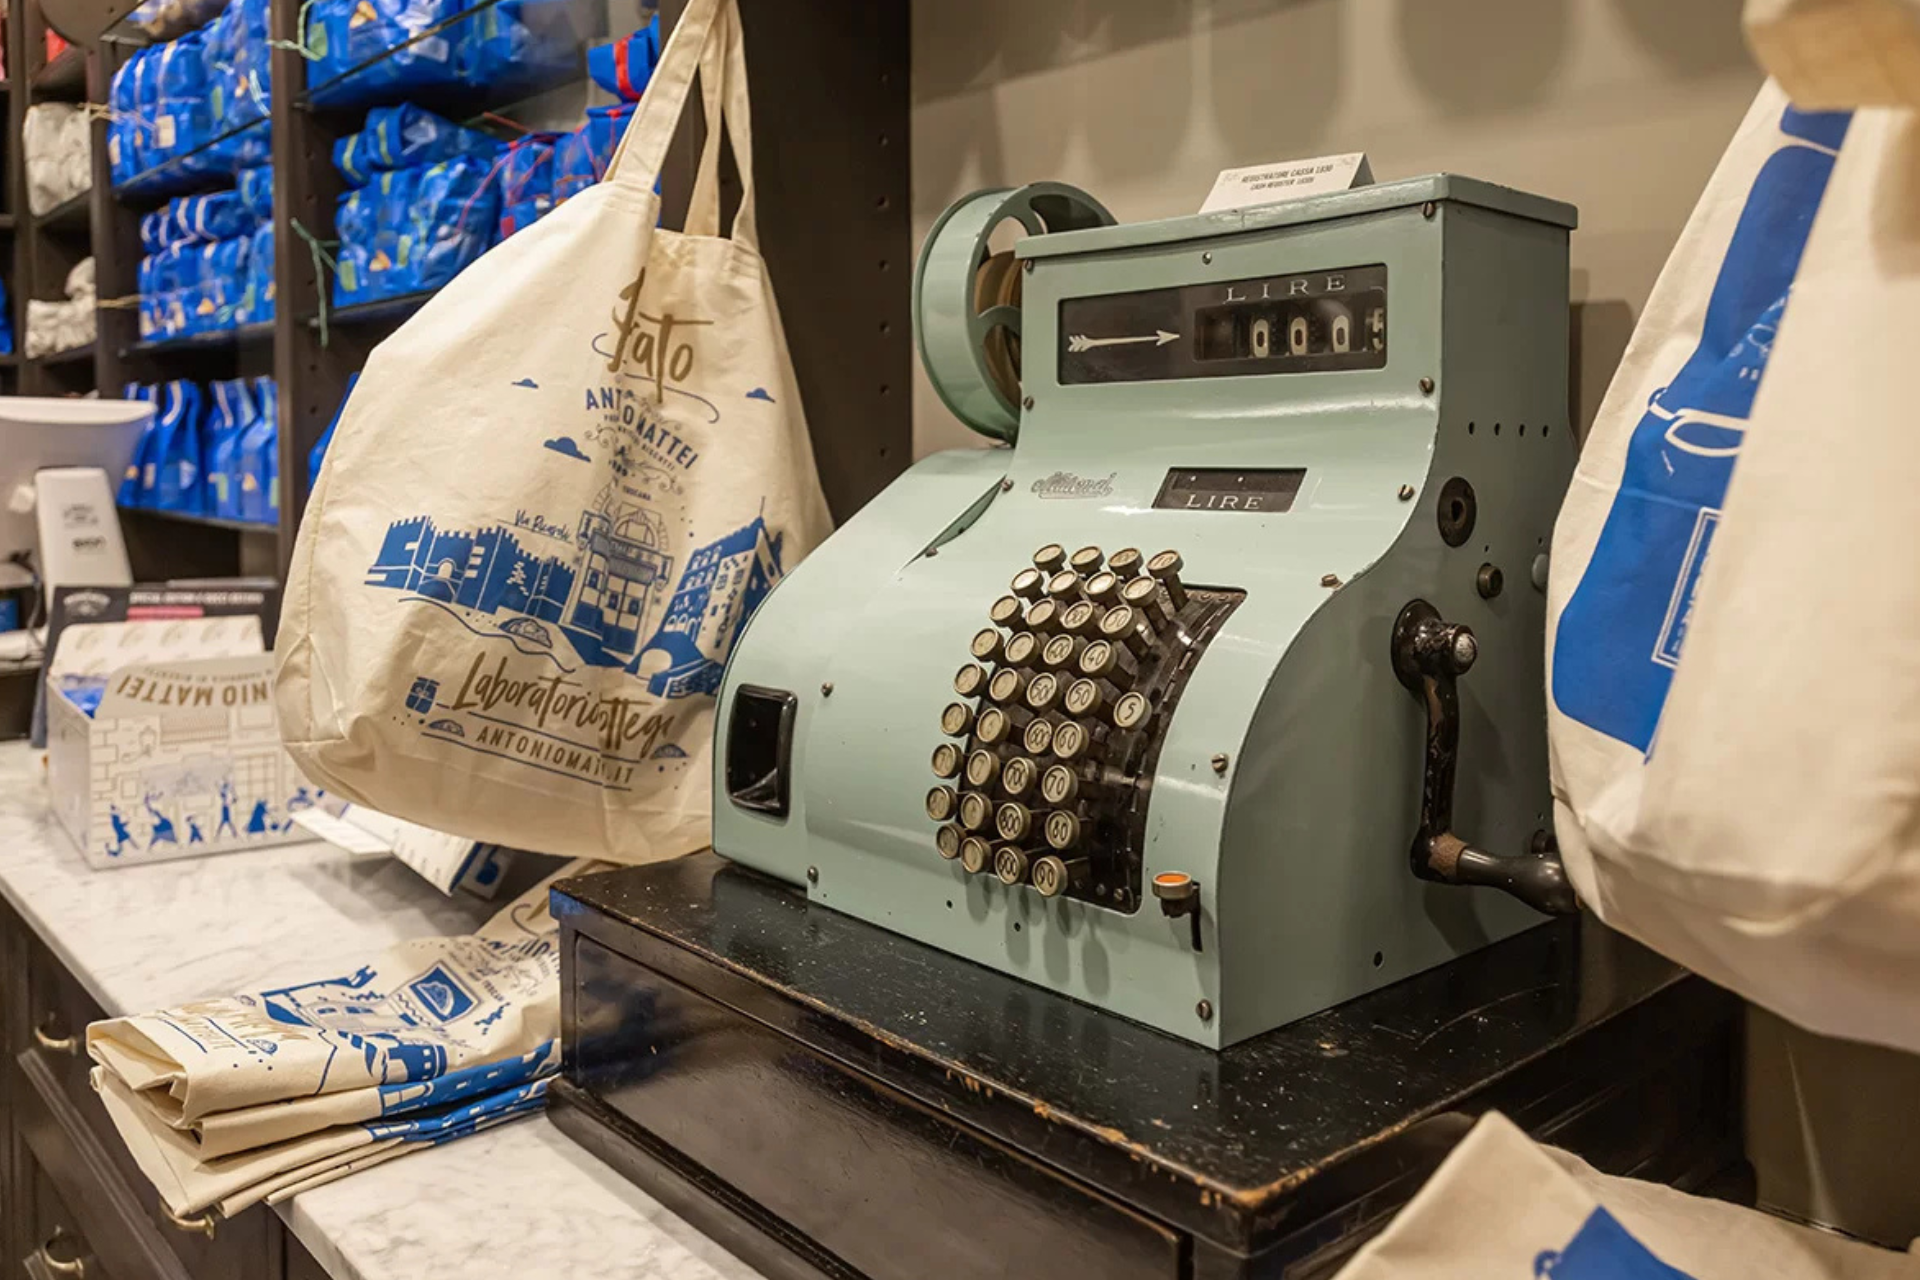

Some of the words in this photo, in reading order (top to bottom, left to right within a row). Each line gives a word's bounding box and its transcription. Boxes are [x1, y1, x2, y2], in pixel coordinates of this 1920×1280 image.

[1225, 274, 1346, 304] LIRE
[1185, 494, 1264, 510] LIRE
[117, 675, 214, 707] MATTEI
